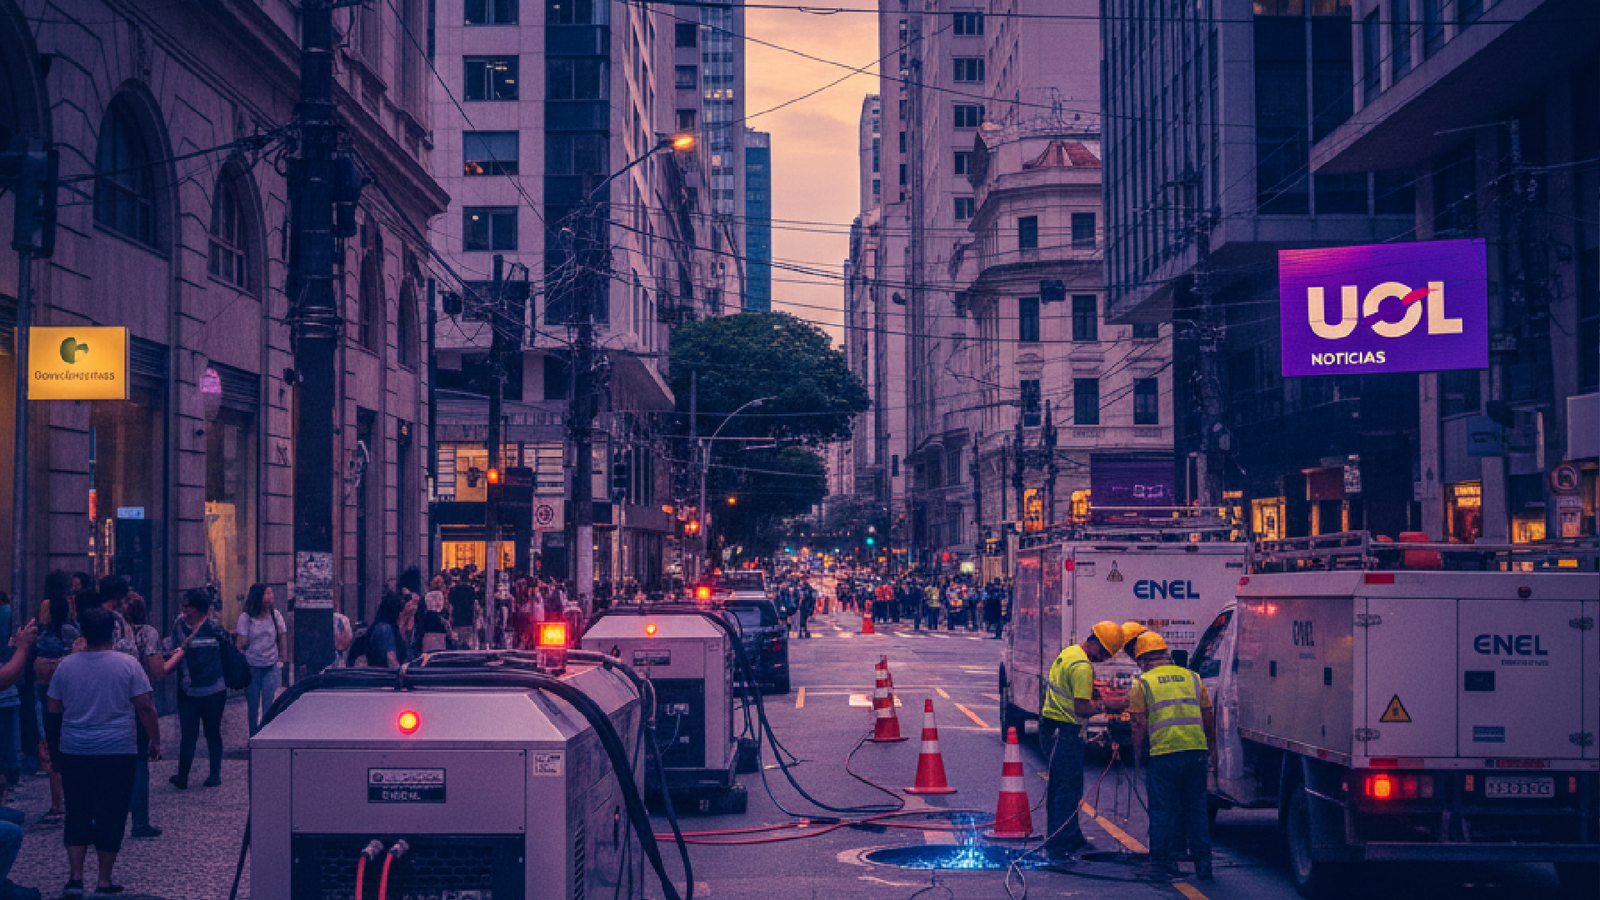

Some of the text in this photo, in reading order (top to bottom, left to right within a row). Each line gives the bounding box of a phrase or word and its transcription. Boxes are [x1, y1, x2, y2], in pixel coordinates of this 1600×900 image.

[1308, 281, 1463, 339] UOL
[1311, 351, 1386, 366] NOTICIAS
[1133, 579, 1200, 599] ENEL
[1473, 634, 1548, 656] ENEL
